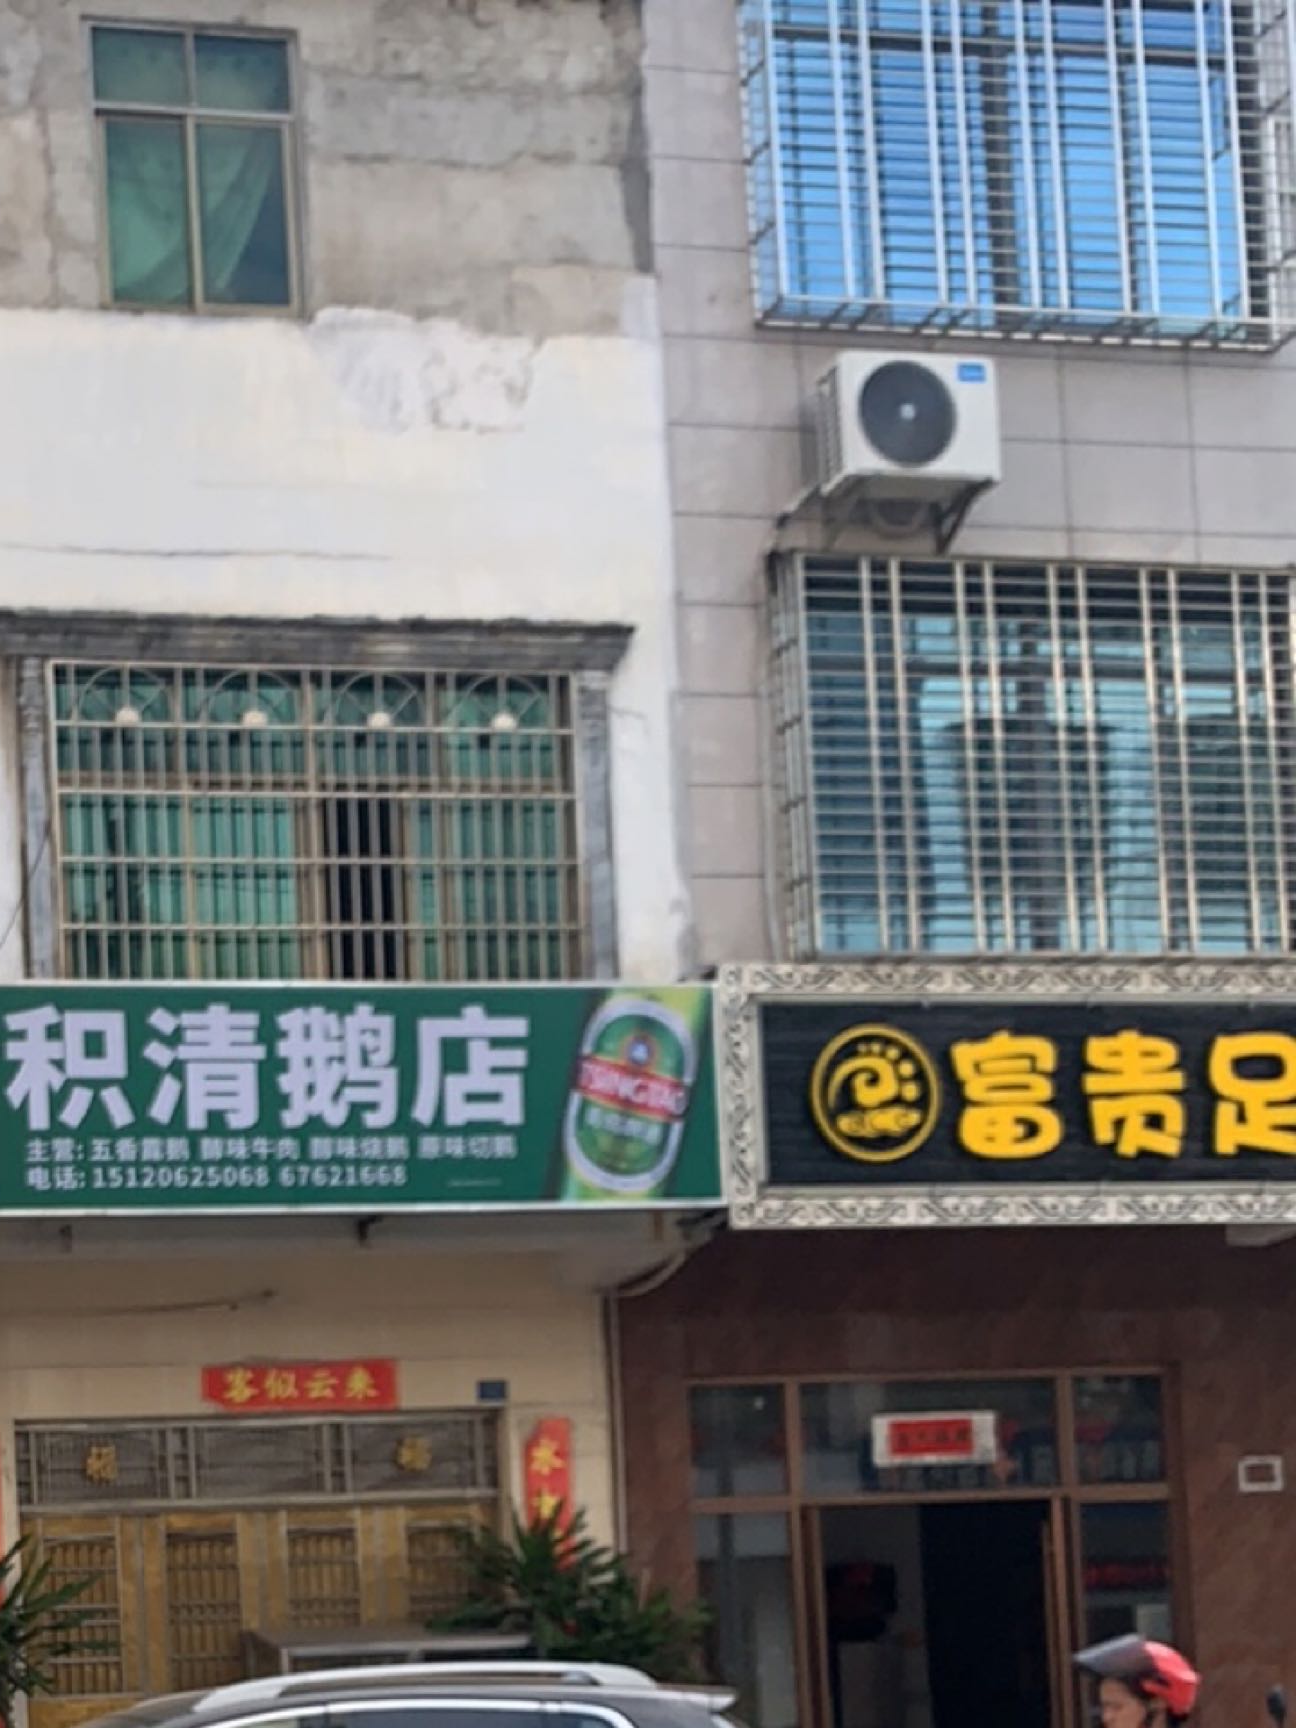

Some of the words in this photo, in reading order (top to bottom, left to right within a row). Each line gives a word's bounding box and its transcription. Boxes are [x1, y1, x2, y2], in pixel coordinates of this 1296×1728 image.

[2, 1002, 529, 1131] 积清鹅店
[949, 1028, 1296, 1160] 富贵足
